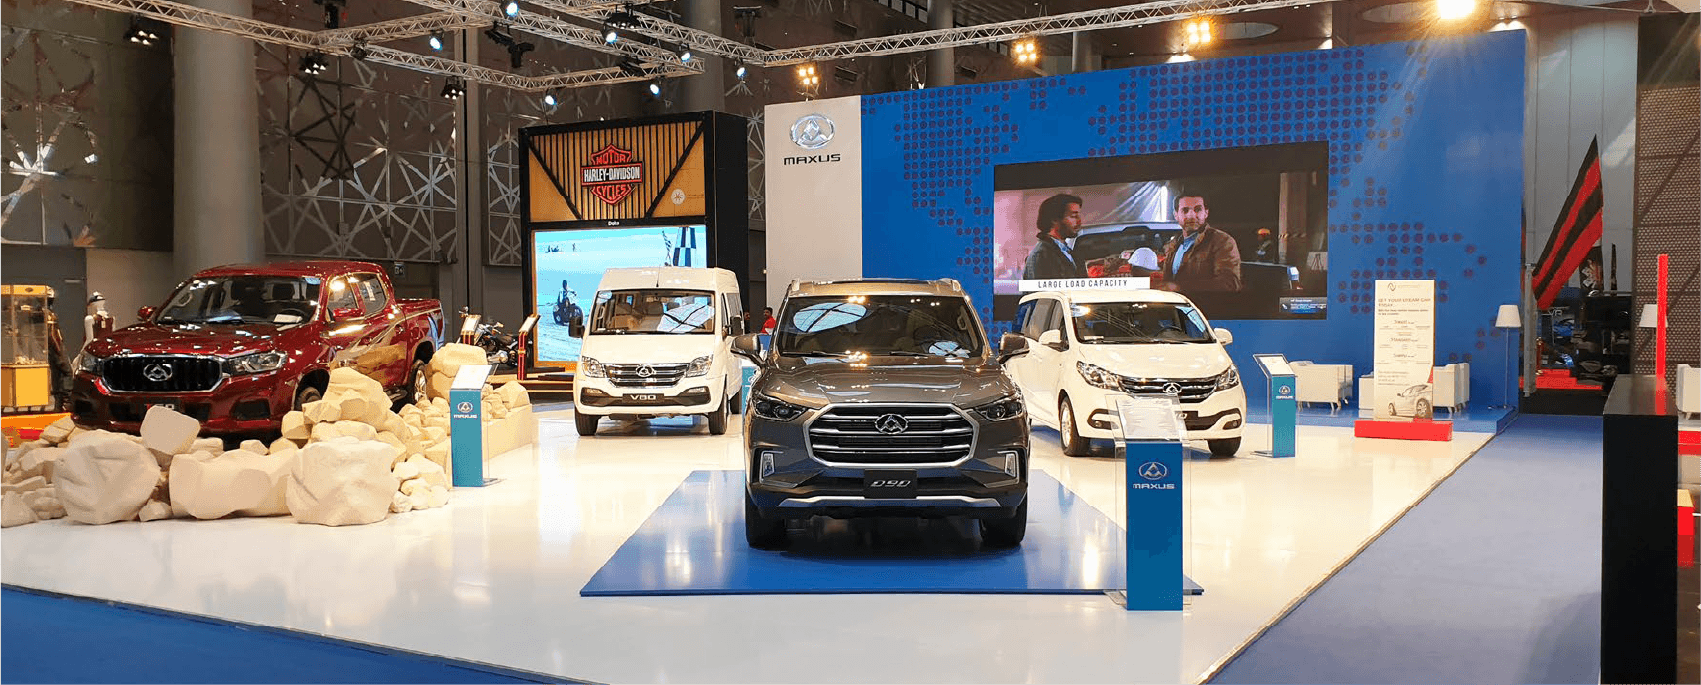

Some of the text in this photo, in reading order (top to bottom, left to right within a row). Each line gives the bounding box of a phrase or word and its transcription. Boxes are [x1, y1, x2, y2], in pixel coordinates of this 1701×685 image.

[596, 150, 626, 165] MOTOR
[784, 153, 841, 165] MAXUS
[584, 167, 640, 182] HARLEY-DAVIDSON
[596, 184, 627, 197] CYCLES
[1037, 279, 1128, 289] LARGE LOAD CAPACITY
